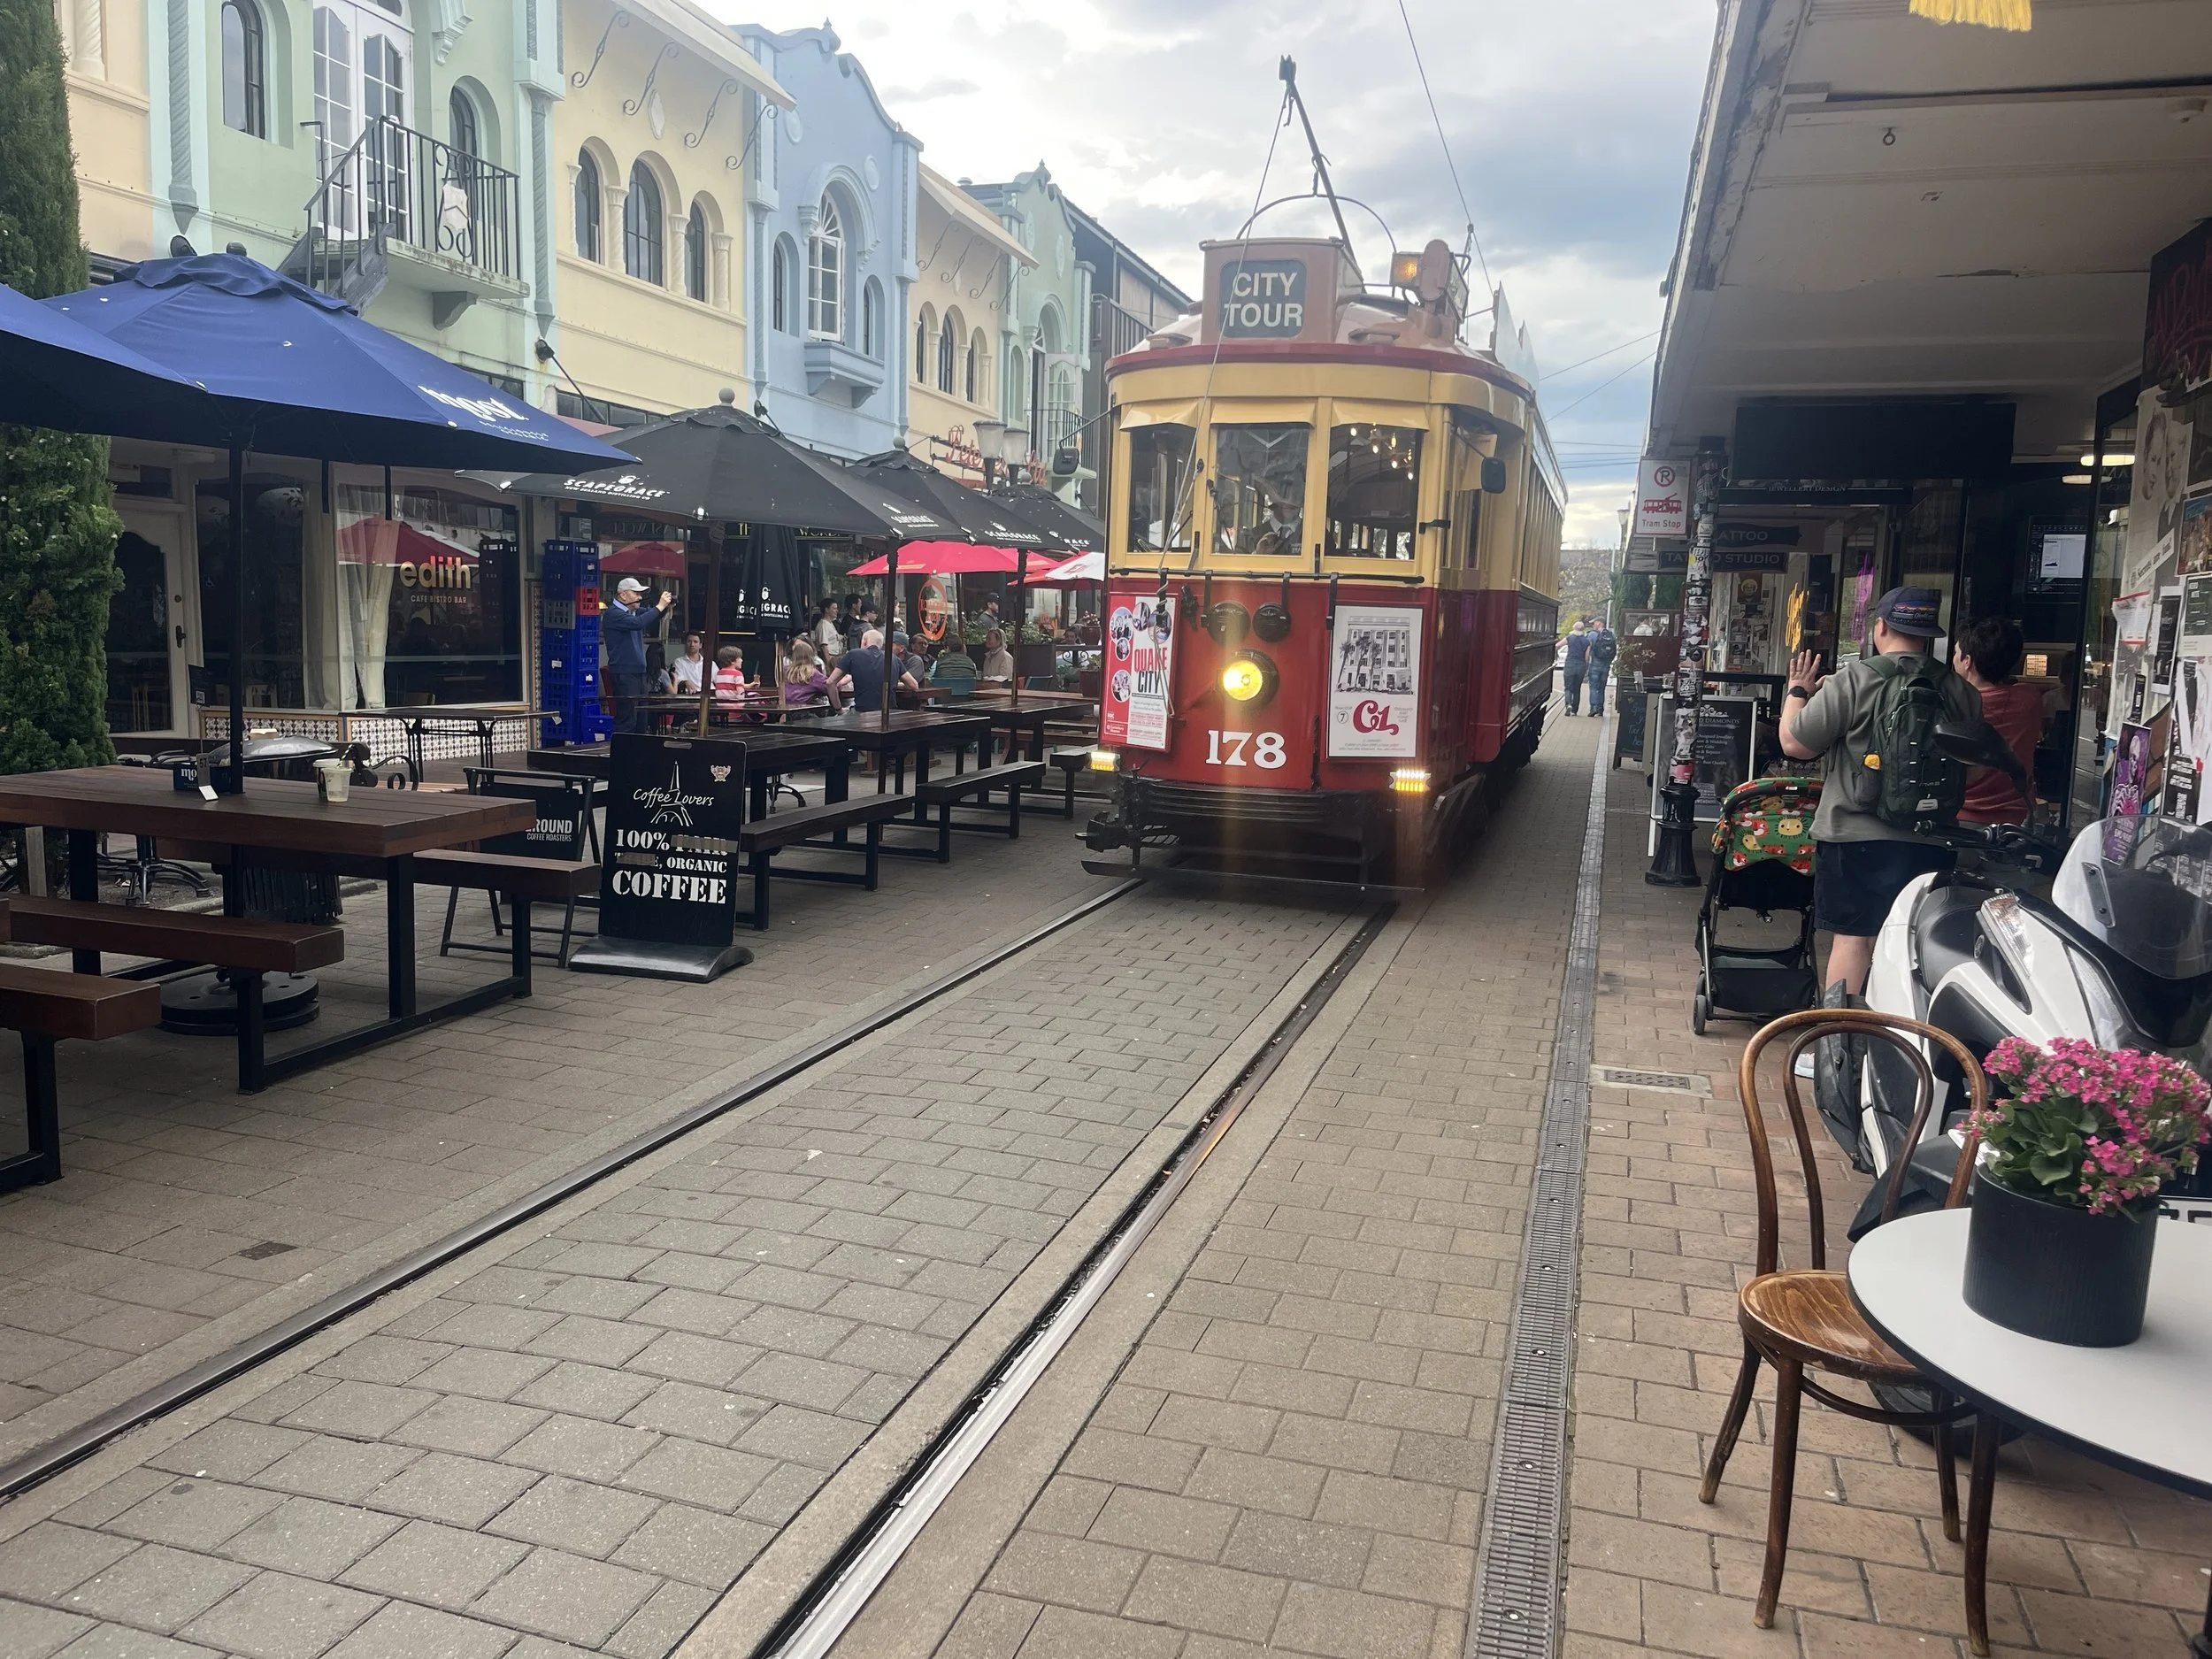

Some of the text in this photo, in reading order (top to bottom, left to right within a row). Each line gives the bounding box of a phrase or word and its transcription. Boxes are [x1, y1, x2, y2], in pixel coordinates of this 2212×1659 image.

[1232, 272, 1298, 297] CITY
[1224, 302, 1303, 327] TOUR
[564, 479, 665, 497] SCAPEGRACE
[1642, 518, 1681, 529] Tram Stop
[1717, 531, 1769, 541] ATTOO
[1724, 554, 1780, 565] STUDIO
[399, 555, 472, 589] edith
[1138, 670, 1161, 694] CITY
[1340, 712, 1346, 722] 7
[1205, 729, 1286, 770] 178
[633, 787, 714, 809] Coffee Lovers
[616, 829, 670, 851] 100%
[666, 856, 727, 873] ORGANIC
[612, 870, 727, 904] COFFEE
